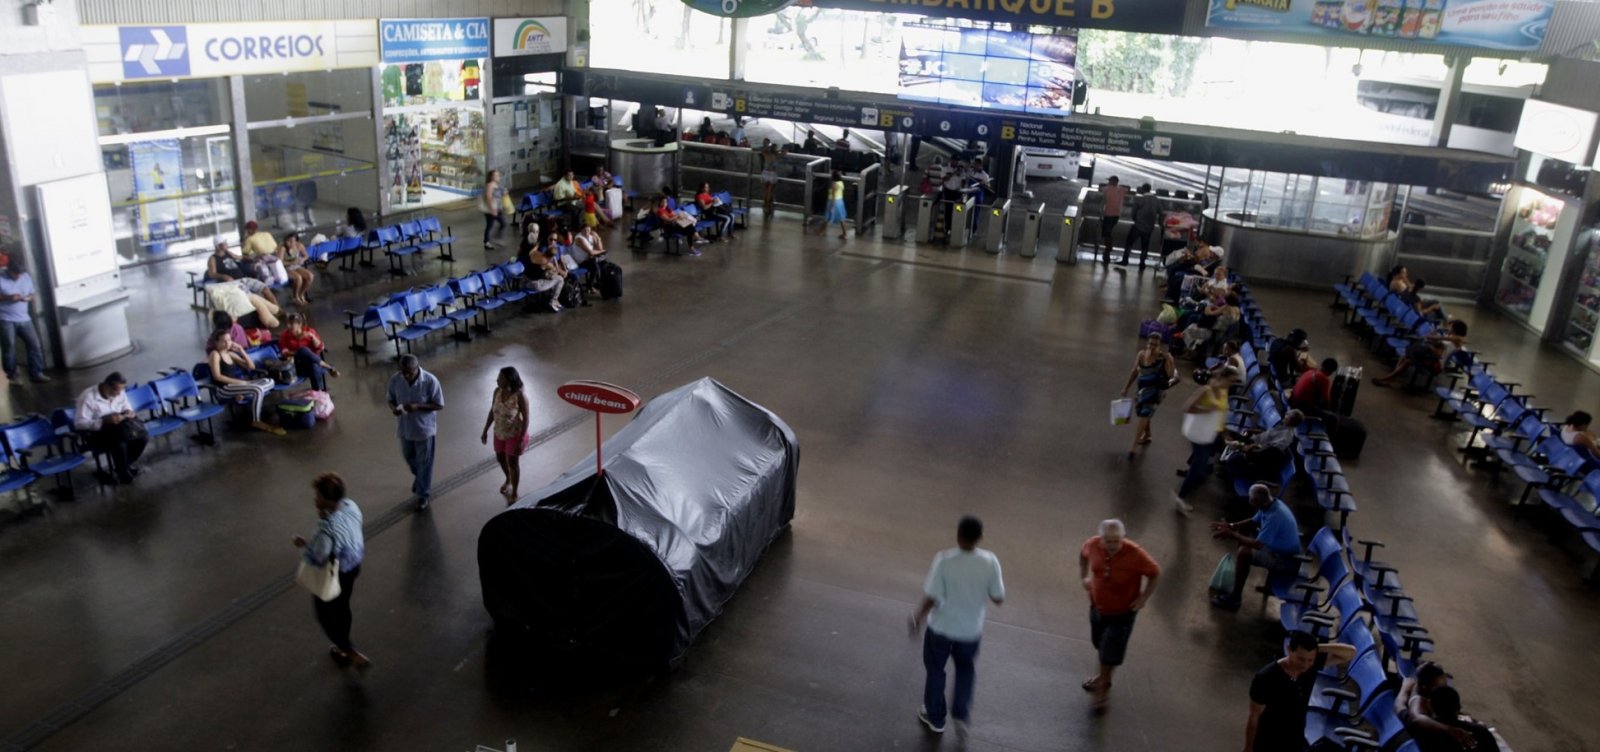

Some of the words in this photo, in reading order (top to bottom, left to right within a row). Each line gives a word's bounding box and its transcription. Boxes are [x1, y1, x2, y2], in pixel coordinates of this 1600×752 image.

[1090, 0, 1115, 19] B
[1457, 13, 1481, 24] para
[384, 23, 452, 42] CAMISETA
[454, 23, 465, 40] &
[466, 22, 488, 40] CIA
[204, 34, 324, 61] CORREIOS
[735, 99, 746, 112] B
[880, 114, 894, 127] B
[1001, 126, 1015, 139] B
[564, 392, 592, 402] chilli
[593, 396, 627, 409] beans
